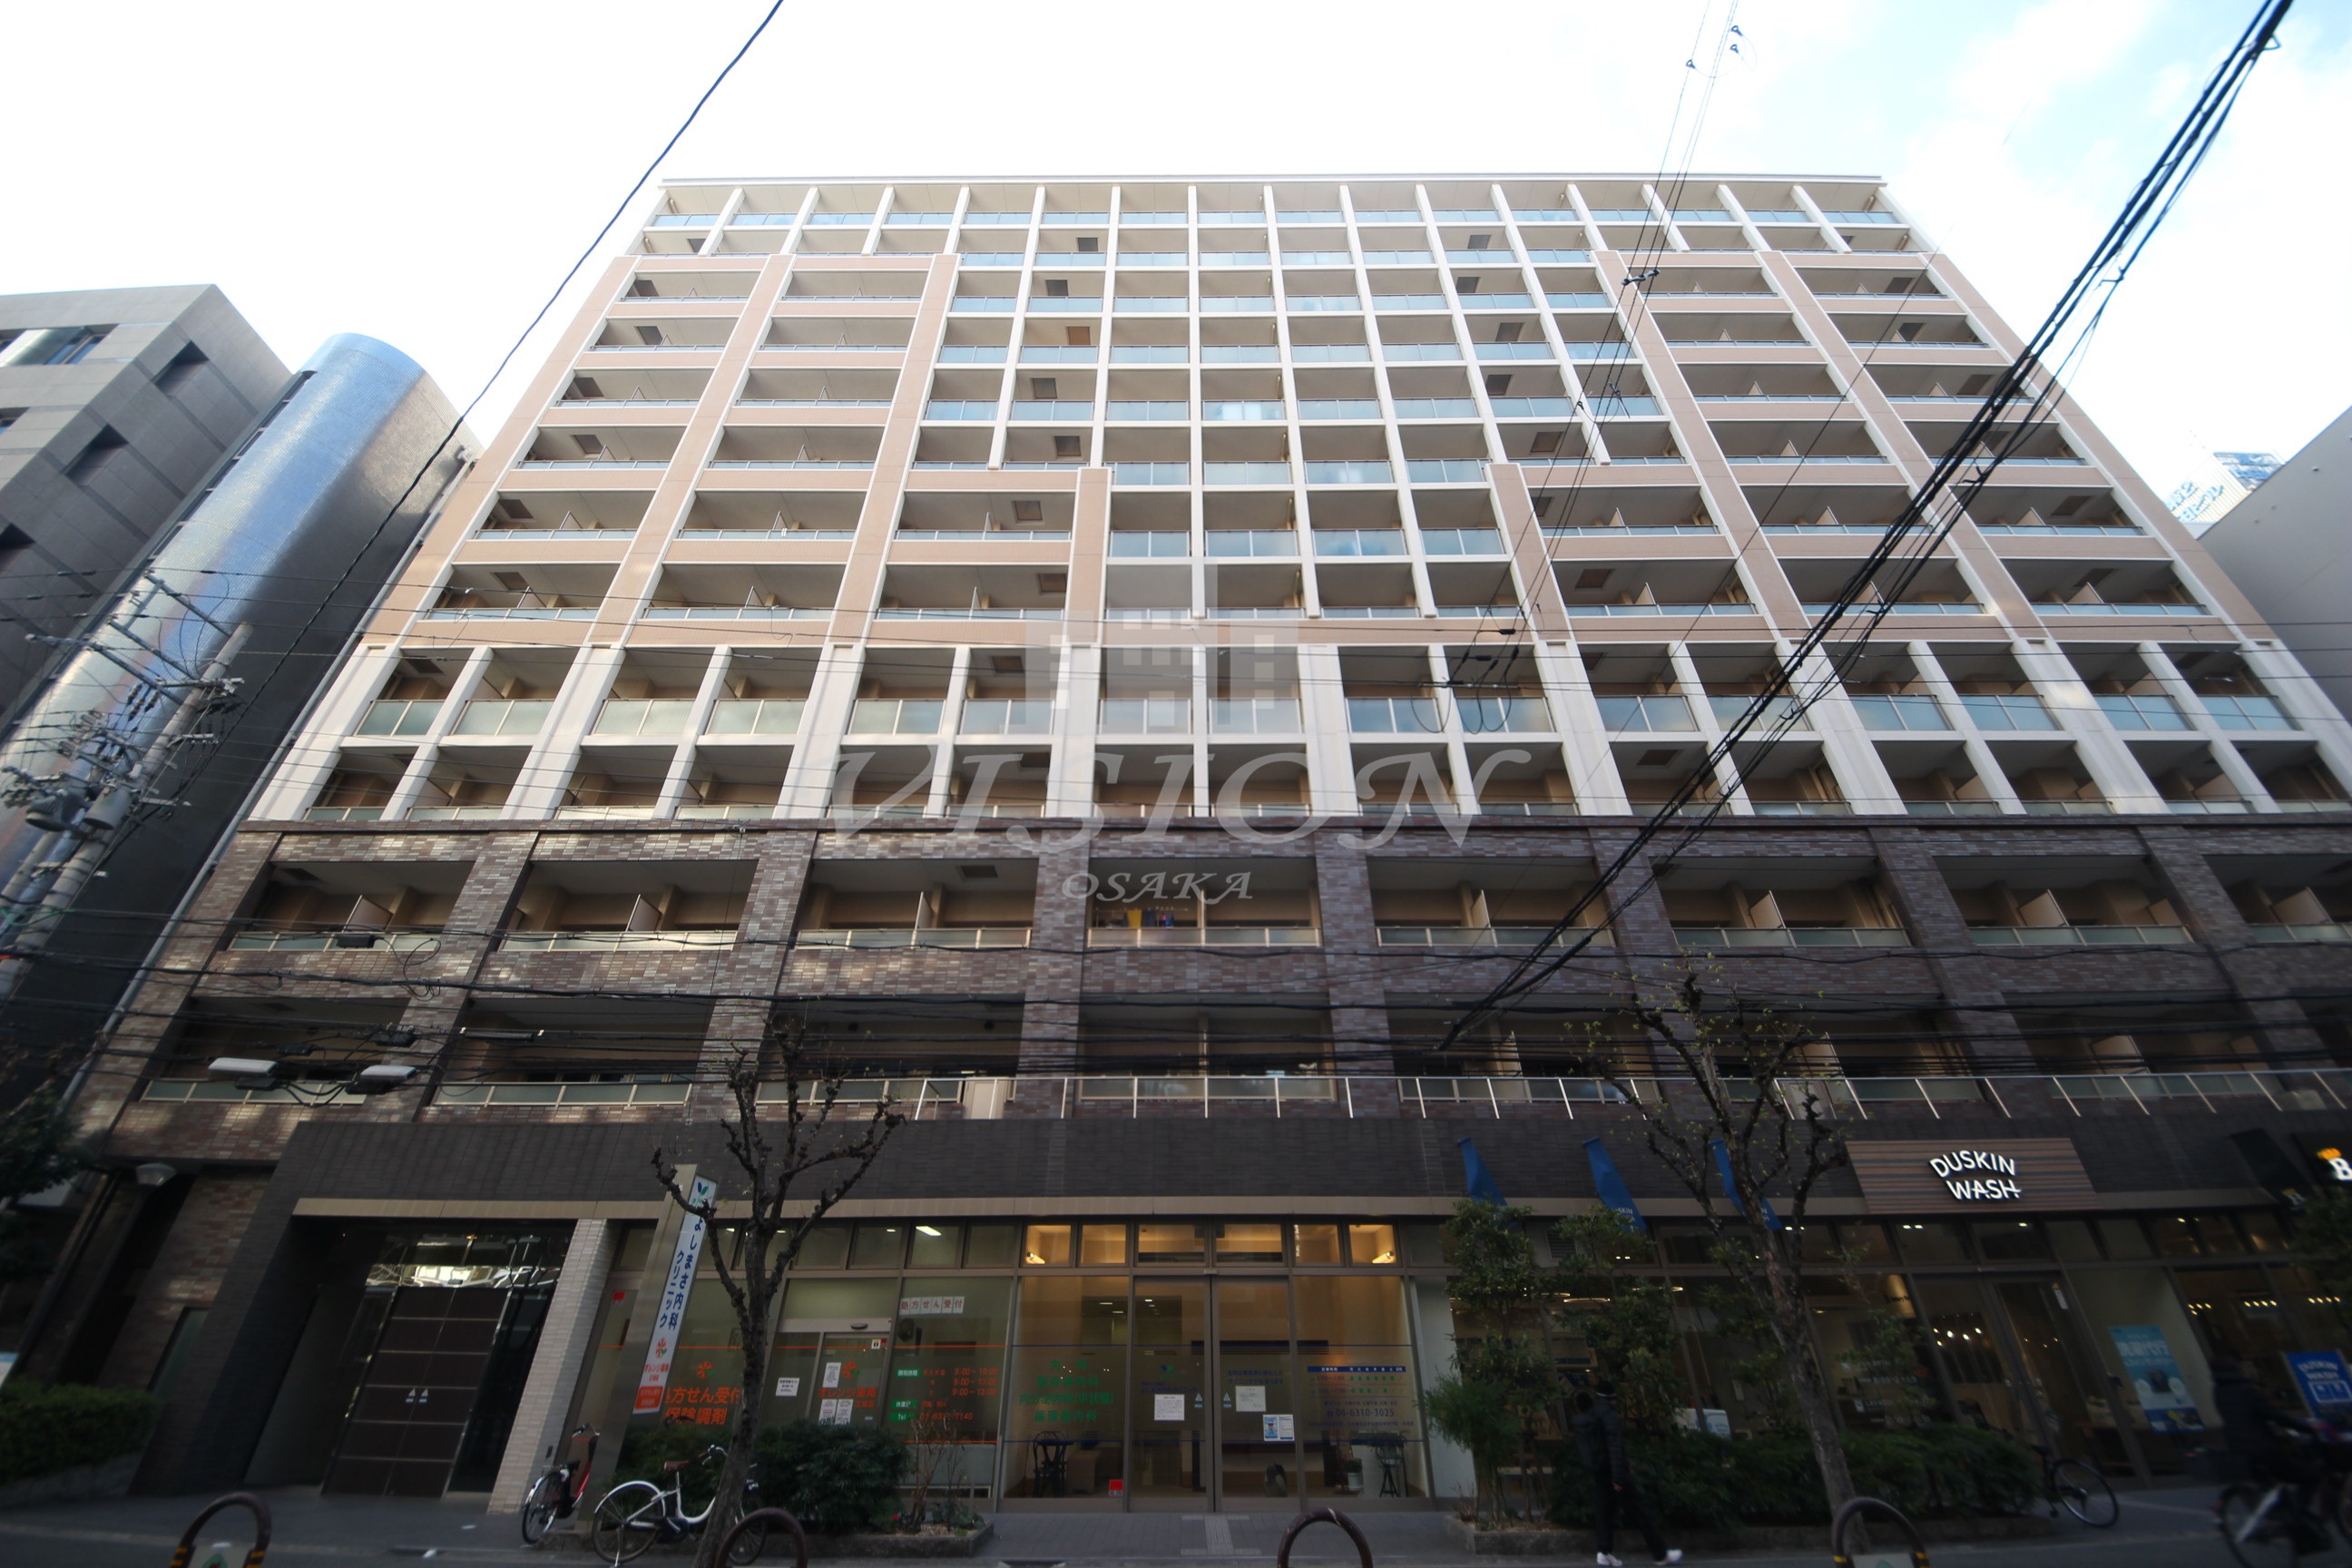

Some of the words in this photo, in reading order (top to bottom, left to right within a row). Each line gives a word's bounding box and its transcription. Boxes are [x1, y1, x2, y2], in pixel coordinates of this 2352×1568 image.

[1929, 1150, 2015, 1178] DUSKIN
[1945, 1179, 2022, 1200] WASH
[668, 1216, 703, 1330] よしまさ内科
[660, 1250, 684, 1328] クリニック
[901, 1298, 962, 1310] 処方せん受付
[1336, 1408, 1395, 1417] 06-6310-3025
